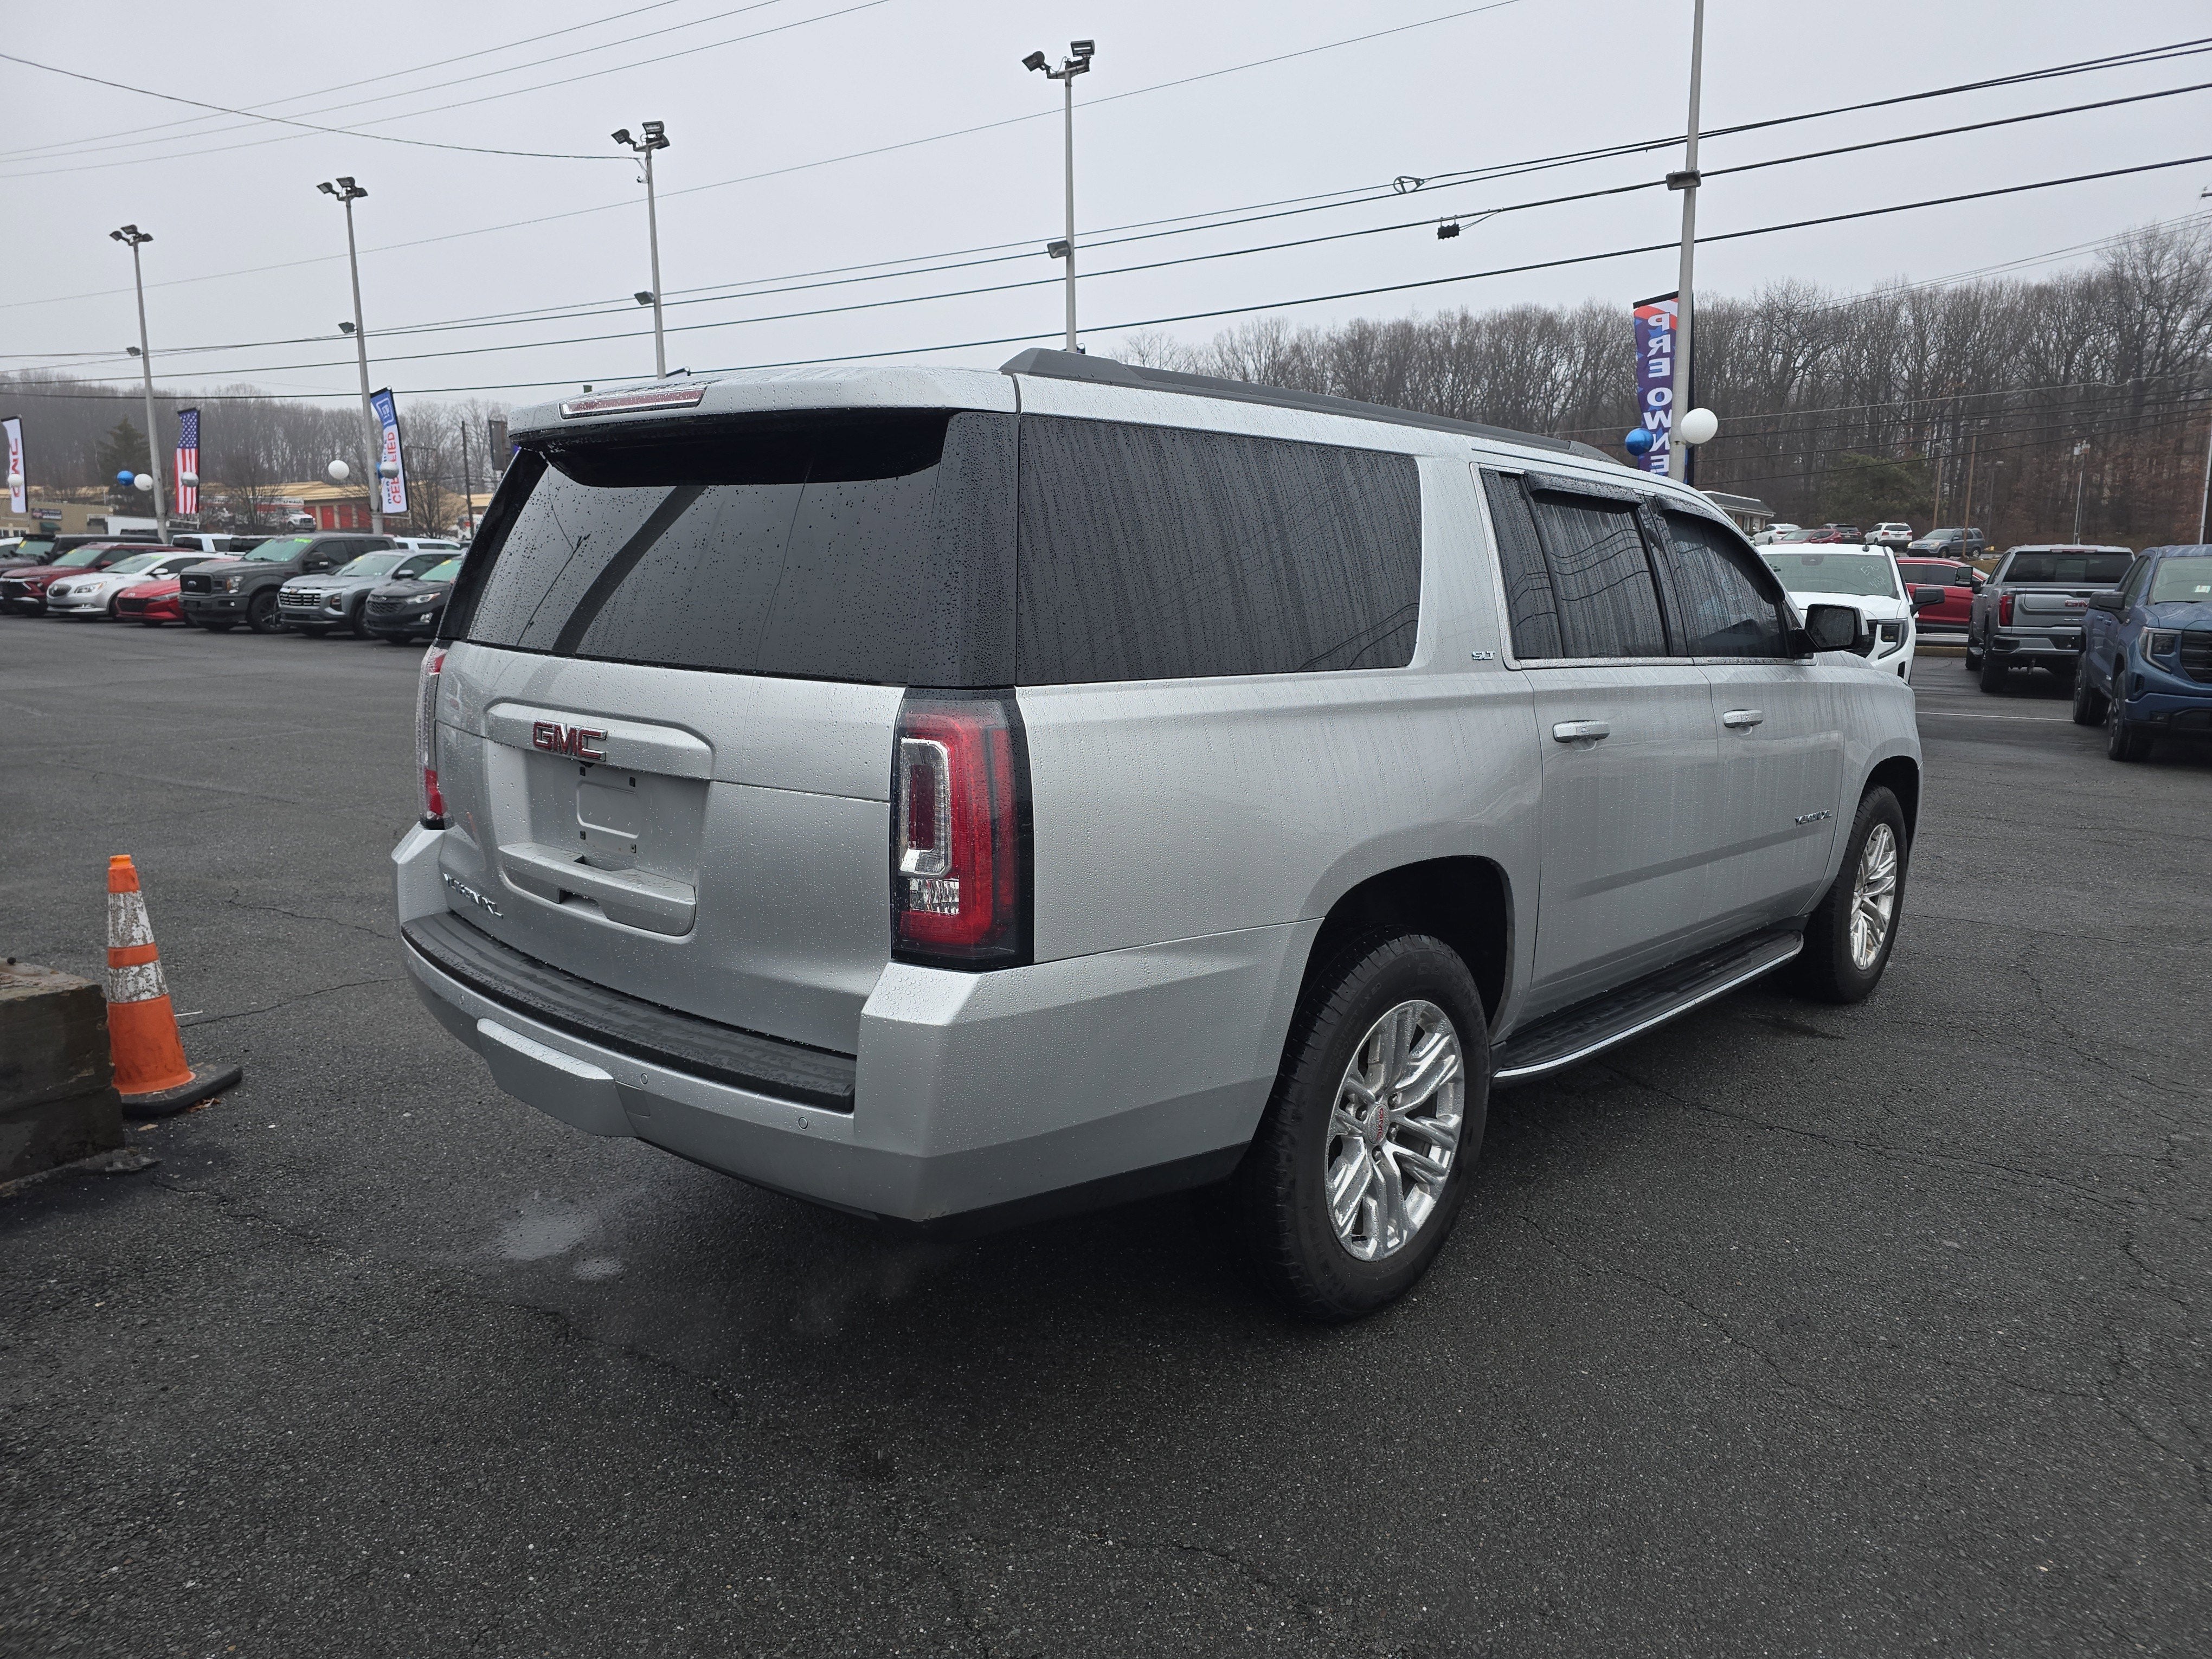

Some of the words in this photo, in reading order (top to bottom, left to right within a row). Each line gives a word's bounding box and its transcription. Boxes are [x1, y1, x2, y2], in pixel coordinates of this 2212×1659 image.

[2065, 599, 2088, 608] GM
[1471, 651, 1496, 661] SLT
[533, 719, 608, 762] GMC
